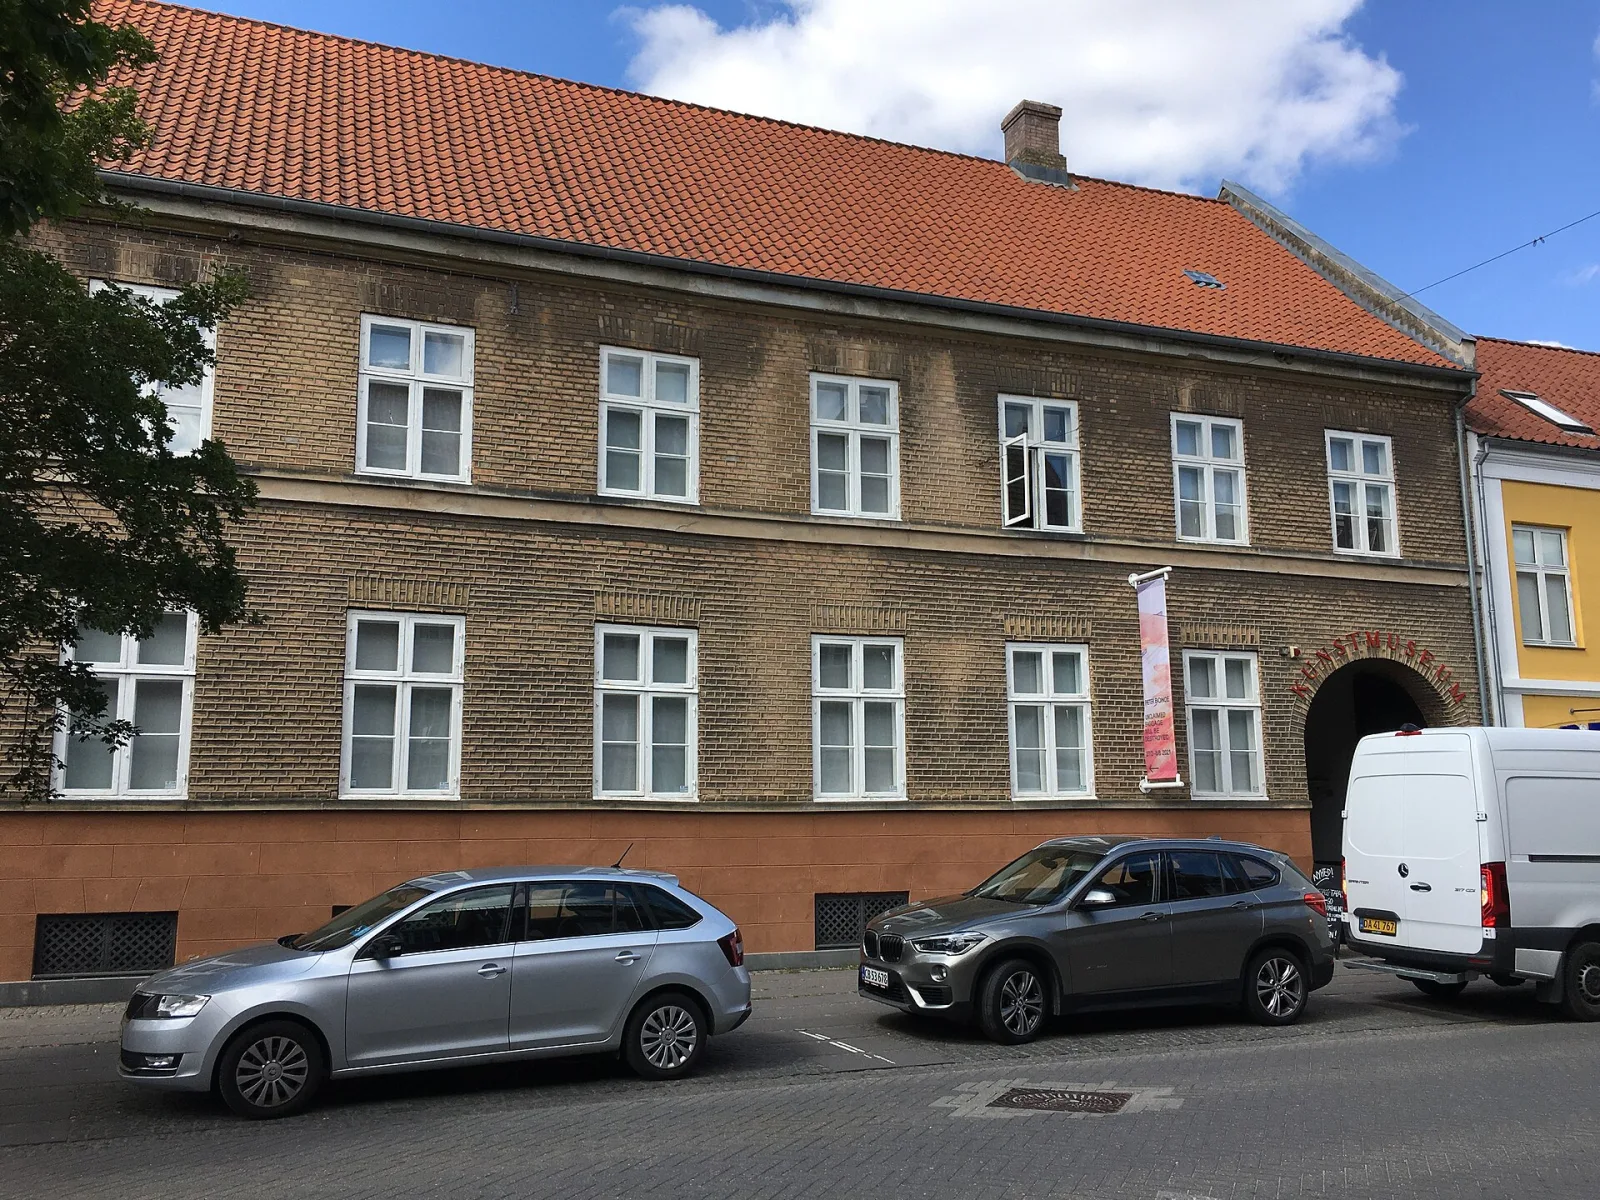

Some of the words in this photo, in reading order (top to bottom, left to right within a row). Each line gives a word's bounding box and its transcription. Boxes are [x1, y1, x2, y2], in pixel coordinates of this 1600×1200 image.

[1290, 631, 1466, 704] KUNSTMUSEUM
[1373, 920, 1381, 930] 41
[1382, 922, 1395, 931] 767
[878, 972, 888, 984] 678
